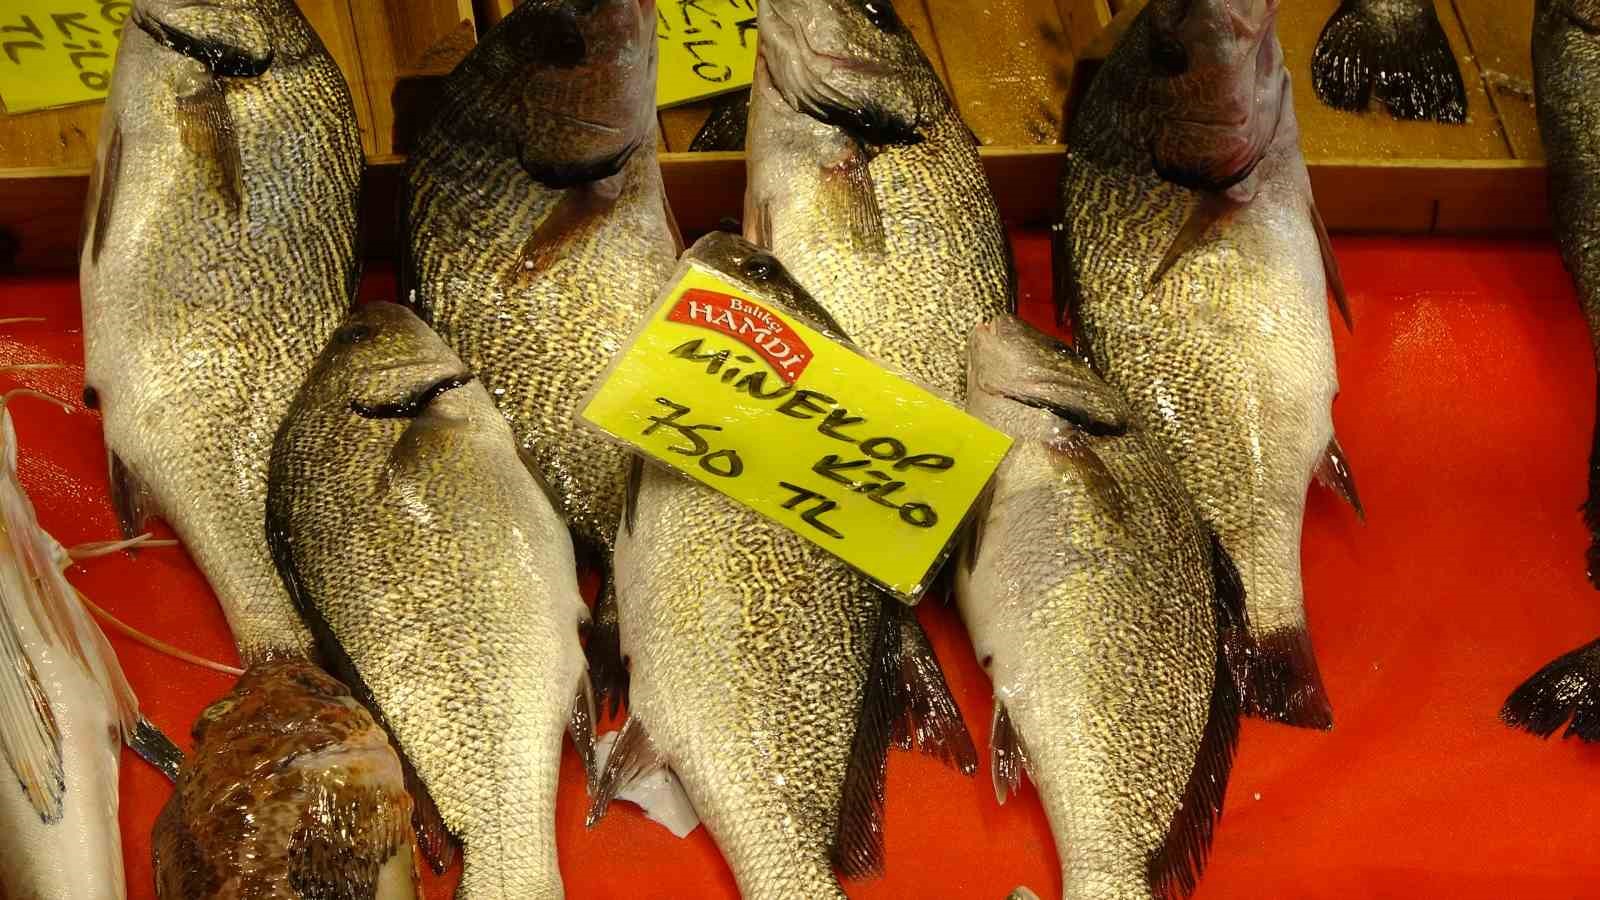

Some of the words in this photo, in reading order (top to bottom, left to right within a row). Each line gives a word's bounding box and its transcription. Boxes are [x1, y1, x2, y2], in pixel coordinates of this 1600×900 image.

[1, 15, 46, 65] TL
[641, 397, 744, 478] 750
[778, 480, 845, 540] TL
